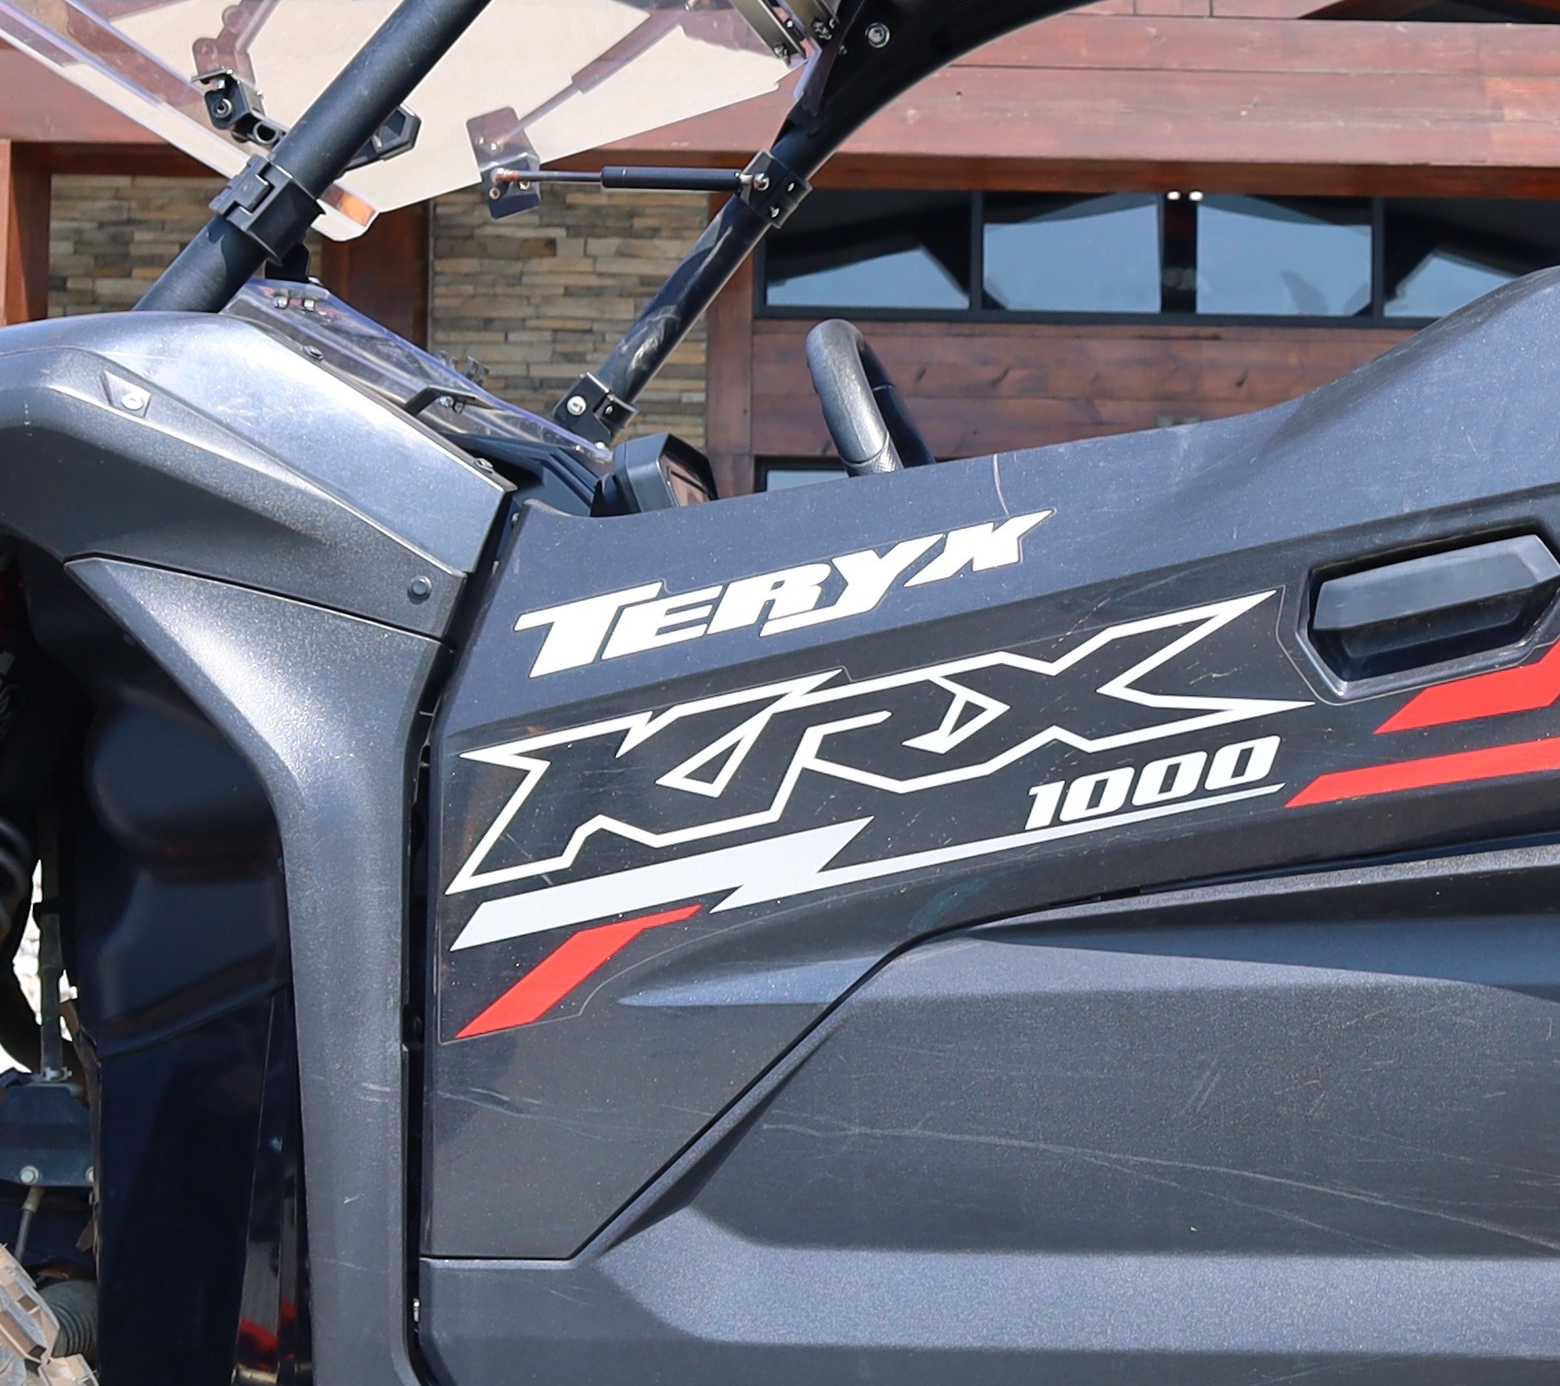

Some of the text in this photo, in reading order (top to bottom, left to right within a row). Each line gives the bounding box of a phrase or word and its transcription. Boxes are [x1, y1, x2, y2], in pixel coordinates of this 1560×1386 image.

[513, 509, 1056, 678] TERYX
[445, 588, 1317, 897] KRX
[1023, 735, 1283, 832] 1000
